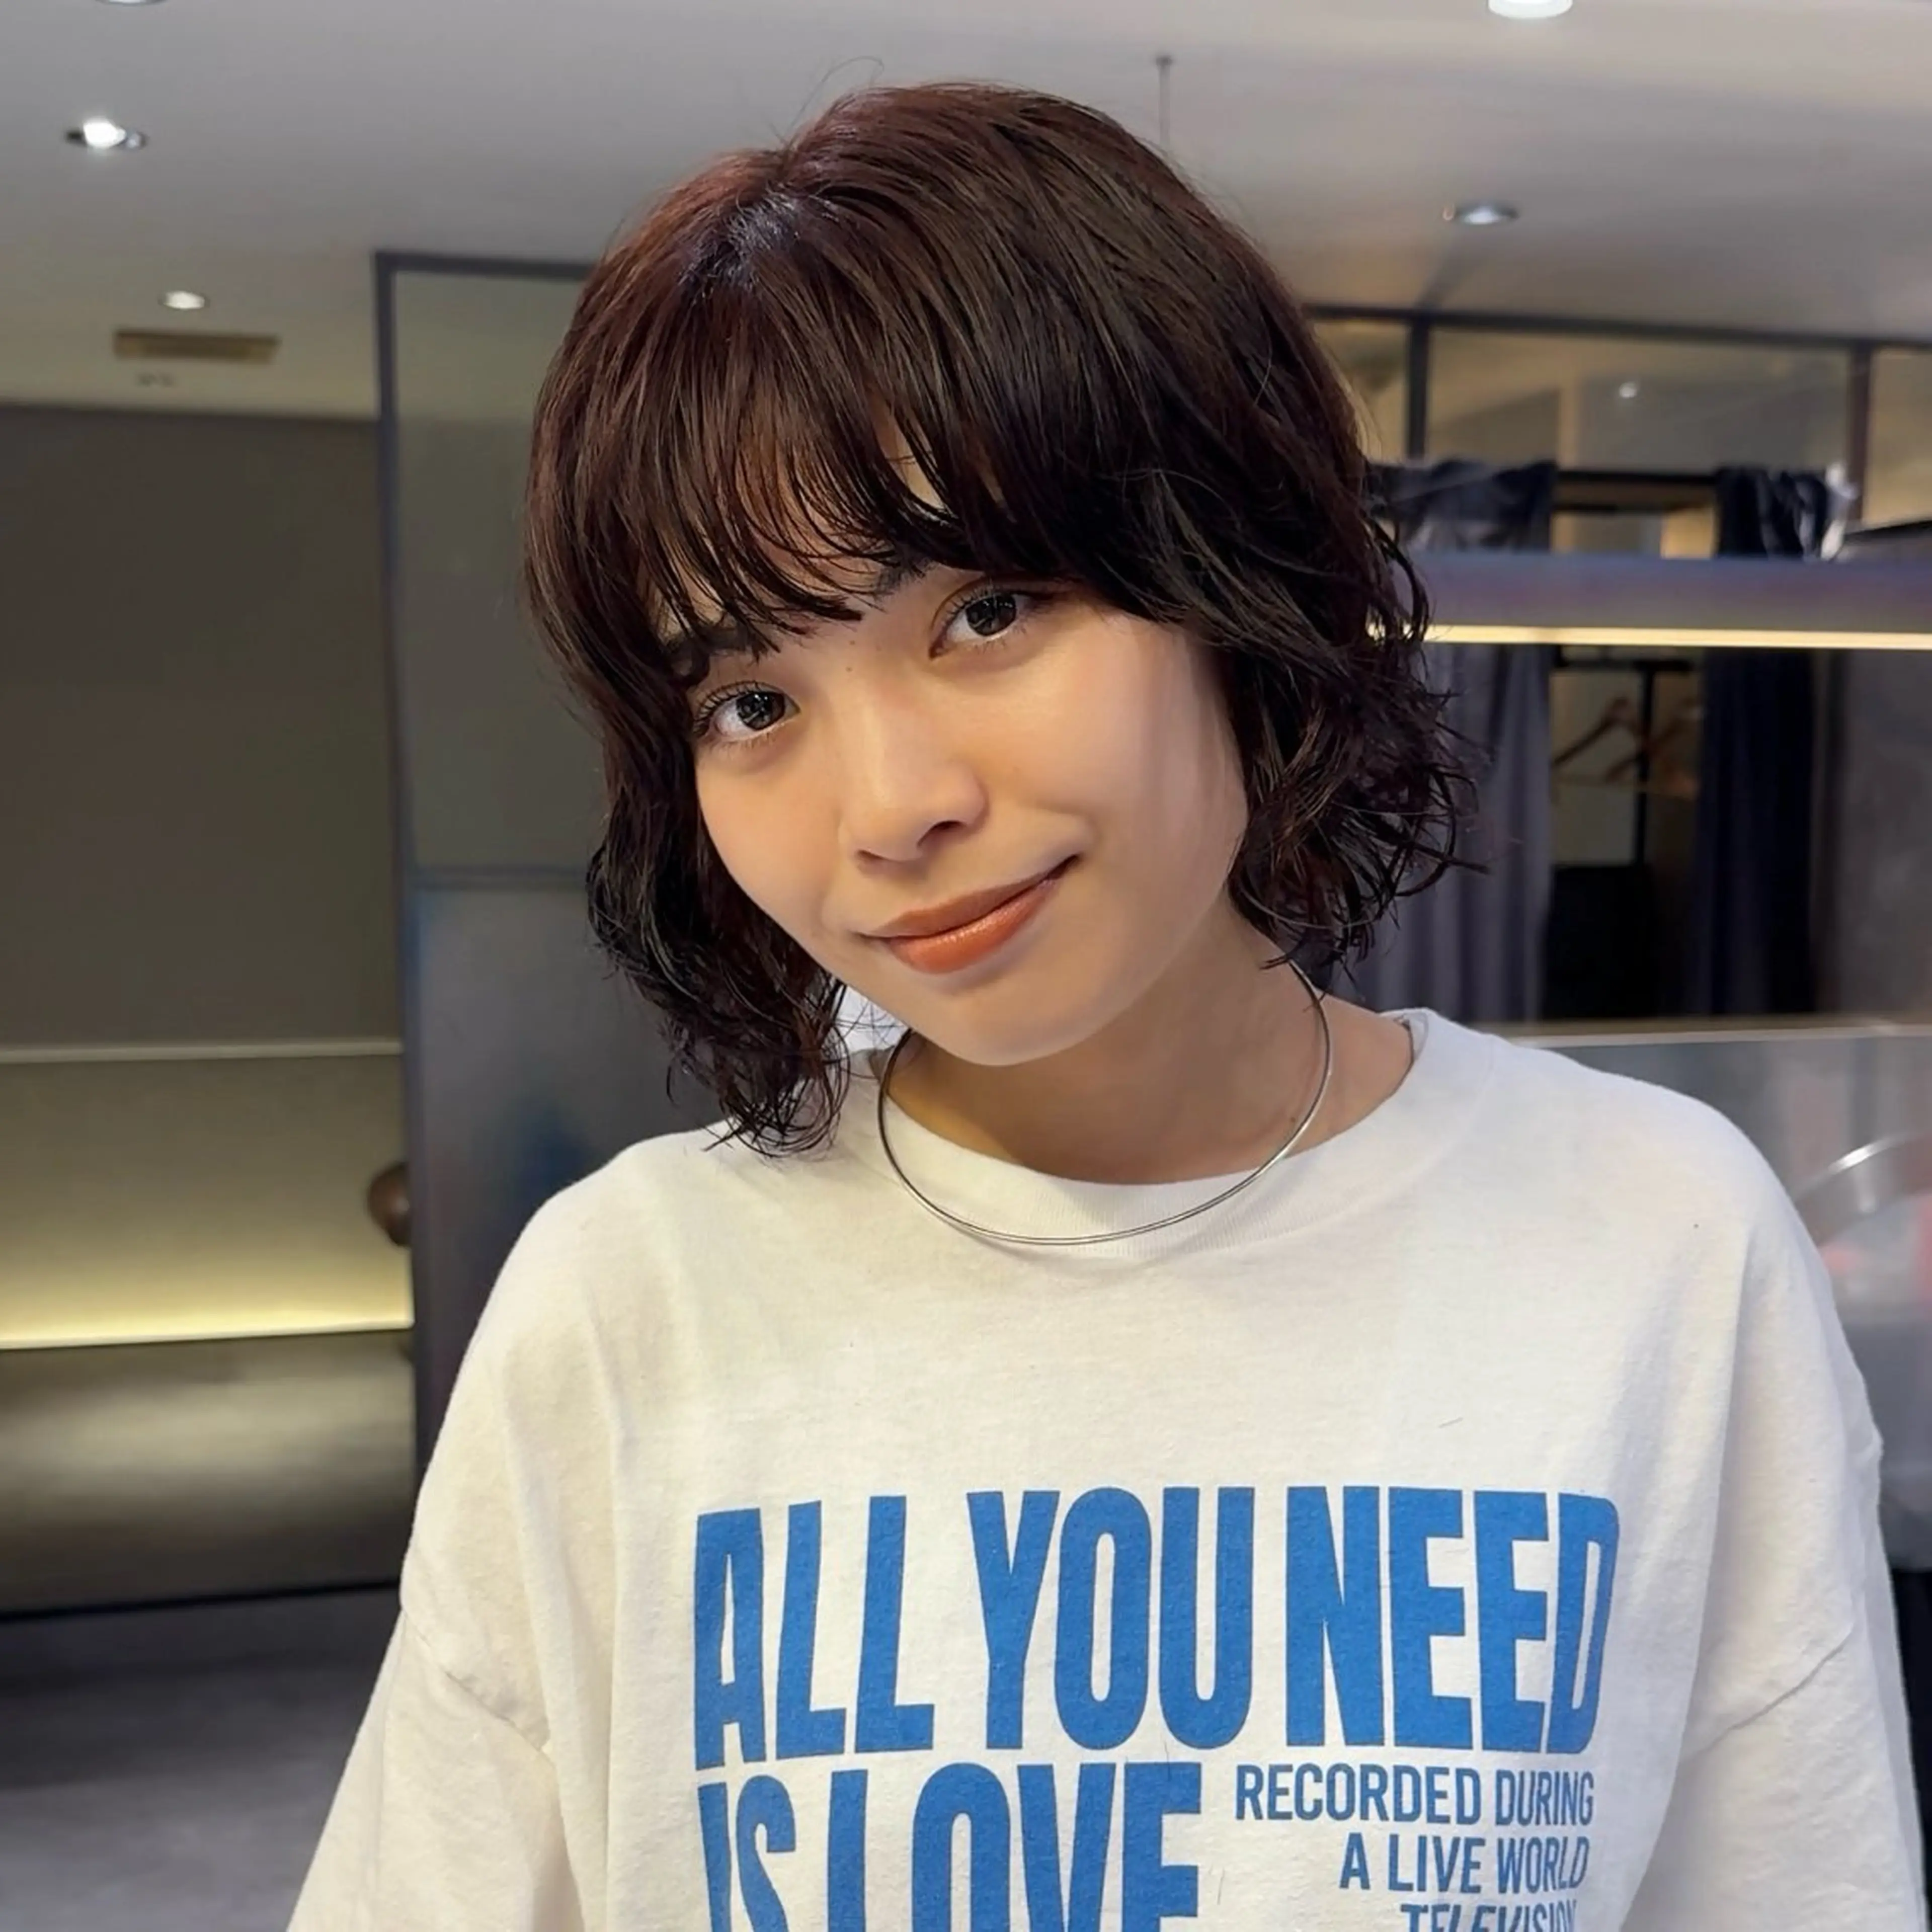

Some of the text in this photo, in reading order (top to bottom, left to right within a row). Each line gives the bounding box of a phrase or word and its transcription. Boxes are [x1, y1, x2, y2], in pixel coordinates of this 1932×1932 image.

[693, 1485, 1620, 1768] ALL YOU NEED
[697, 1760, 1201, 1932] IS LOVE
[1235, 1763, 1594, 1826] RECORDED DURING
[1339, 1832, 1590, 1894] A LIVE WORLD
